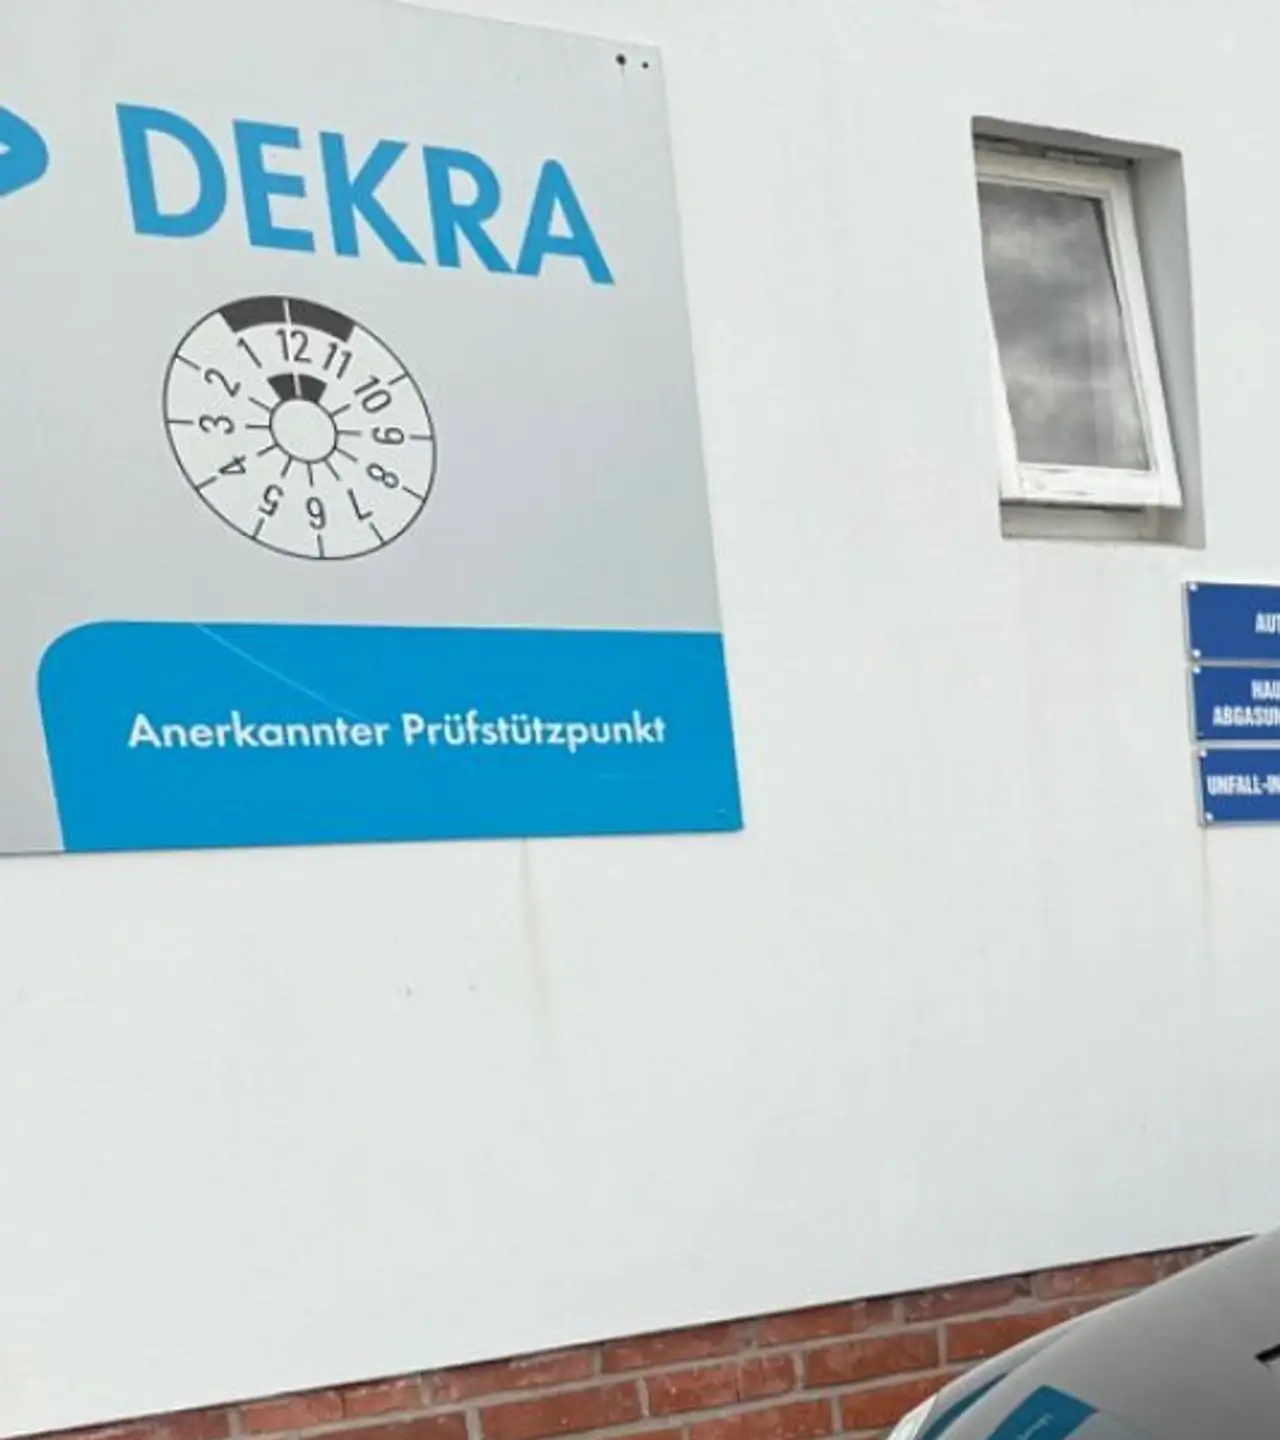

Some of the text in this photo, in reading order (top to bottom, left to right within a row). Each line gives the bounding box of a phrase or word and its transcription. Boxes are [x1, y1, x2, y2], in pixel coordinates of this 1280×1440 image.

[116, 104, 614, 285] DEKRA
[237, 338, 262, 368] 1
[276, 328, 312, 363] 12
[322, 342, 352, 380] 11
[203, 367, 241, 397] 2
[353, 375, 391, 414] 10
[199, 415, 234, 435] 3
[371, 426, 404, 445] 9
[218, 455, 247, 475] 4
[366, 463, 400, 489] 8
[259, 484, 284, 516] 5
[306, 497, 326, 530] 6
[347, 488, 373, 521] 7
[128, 709, 666, 754] Anerkannter Prüfstützpunkt
